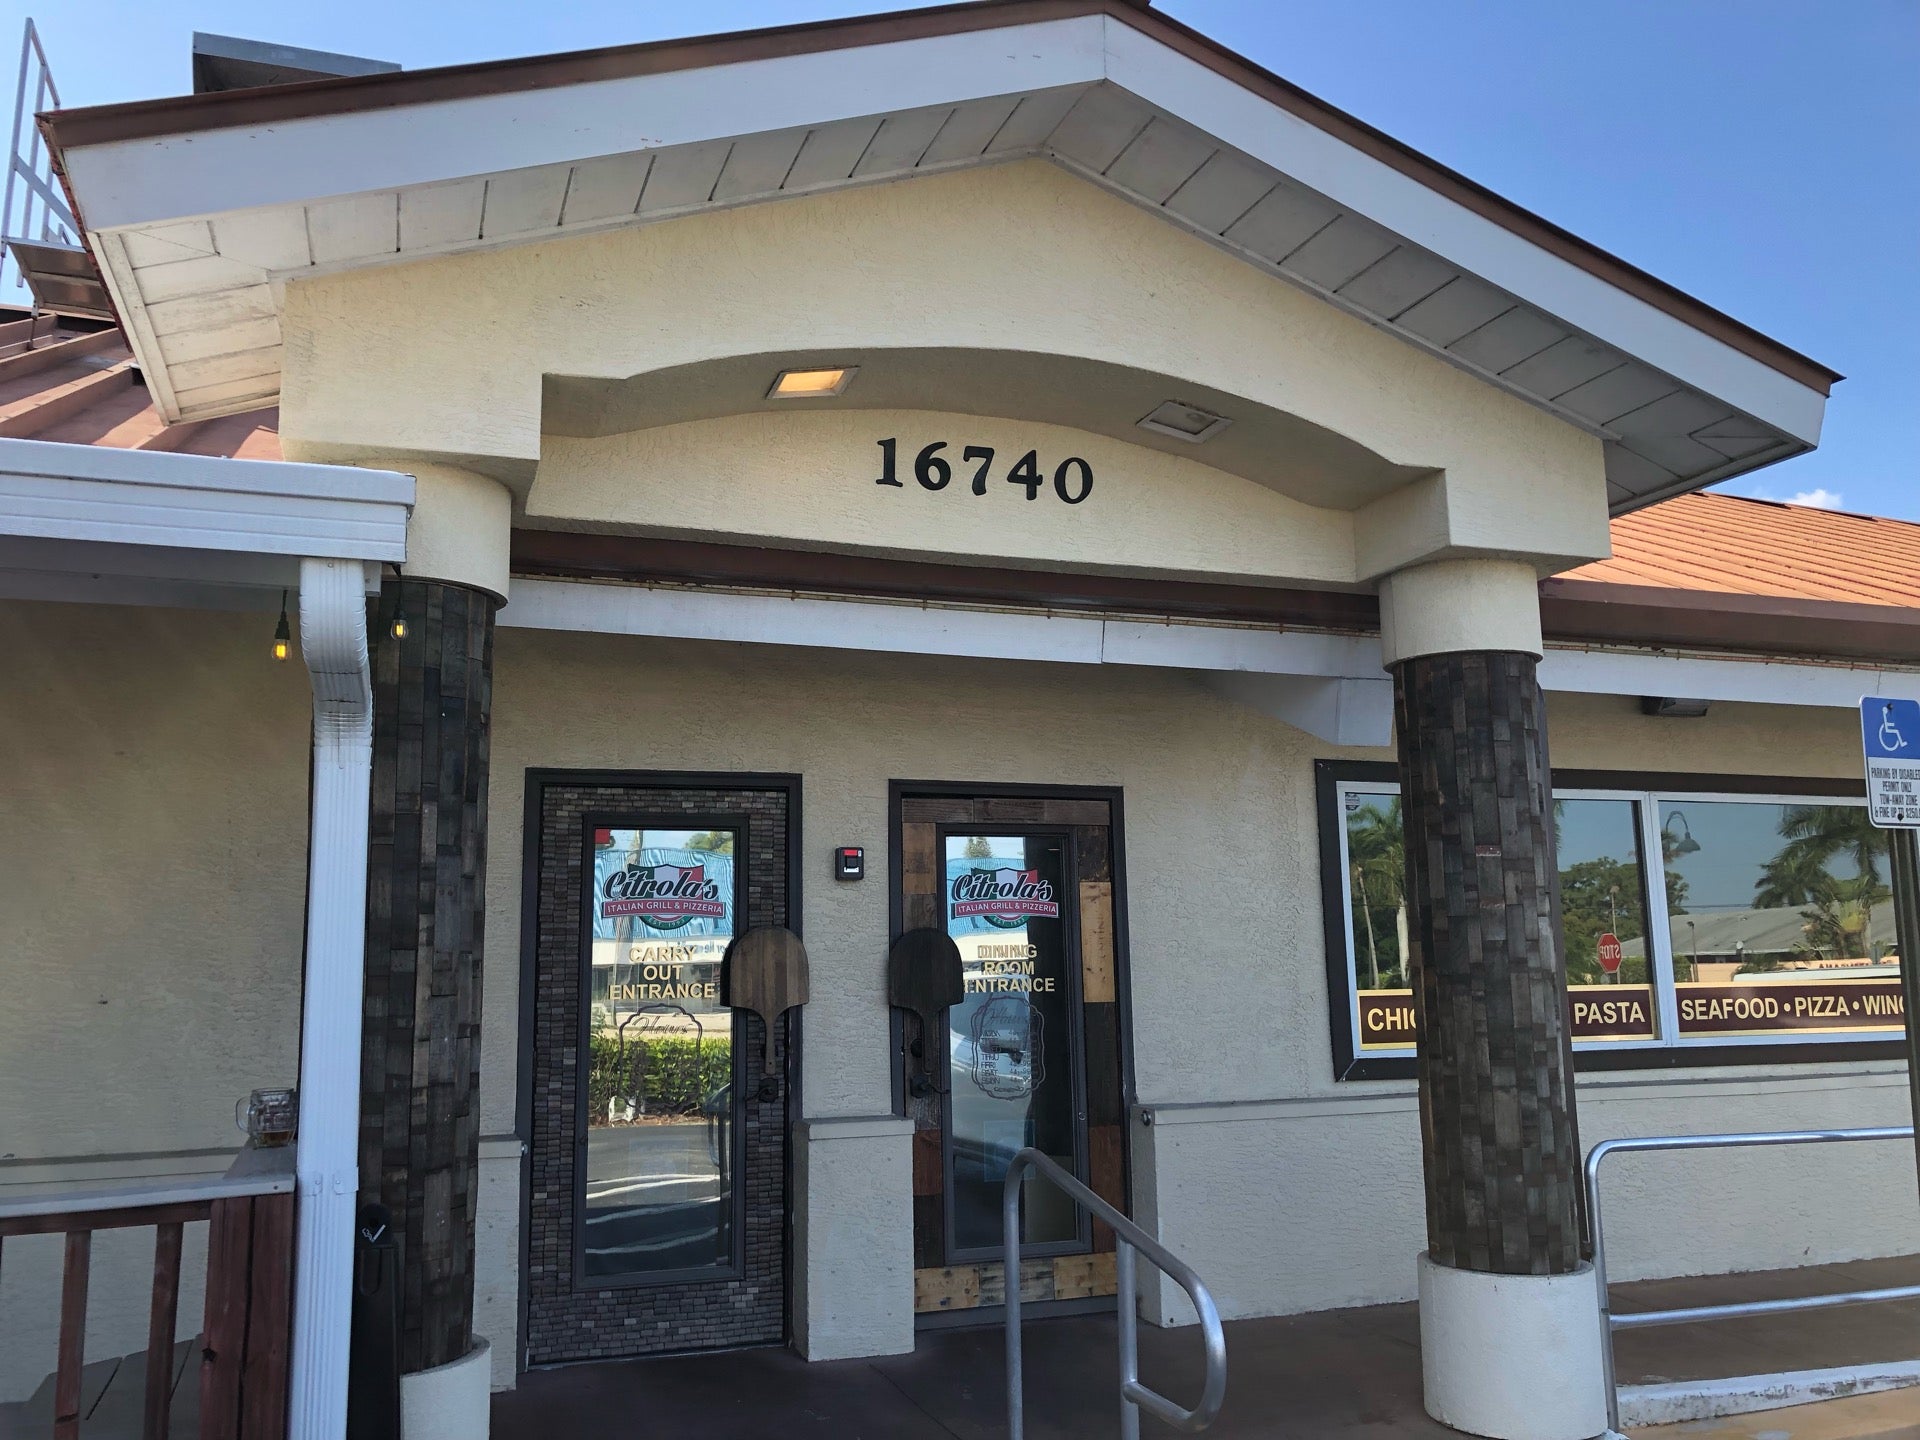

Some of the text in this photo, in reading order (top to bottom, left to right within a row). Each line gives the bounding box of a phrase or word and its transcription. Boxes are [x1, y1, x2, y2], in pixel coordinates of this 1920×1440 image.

[875, 437, 1094, 505] 16740
[1871, 767, 1890, 779] PARKING
[1891, 768, 1898, 779] BY
[1882, 780, 1912, 792] PERMIT ONLY
[1905, 794, 1918, 806] ZONE
[1879, 806, 1890, 818] FINE
[1891, 806, 1897, 818] UP
[603, 870, 719, 900] Citrola's
[953, 872, 1053, 901] Citrola's
[607, 901, 723, 914] ITALIAN GRILL & PIZZERIA
[958, 902, 1057, 913] ITALIAN GRILL & PIZZERIA
[629, 946, 696, 962] CARRY
[643, 964, 684, 980] OUT
[983, 961, 1035, 975] ROOM
[609, 983, 716, 1000] ENTRANCE
[963, 977, 1055, 993] ENTRANCE
[1574, 1001, 1646, 1025] PASTA
[1681, 997, 1779, 1021] SEAFOOD
[1794, 996, 1850, 1018] PIZZA
